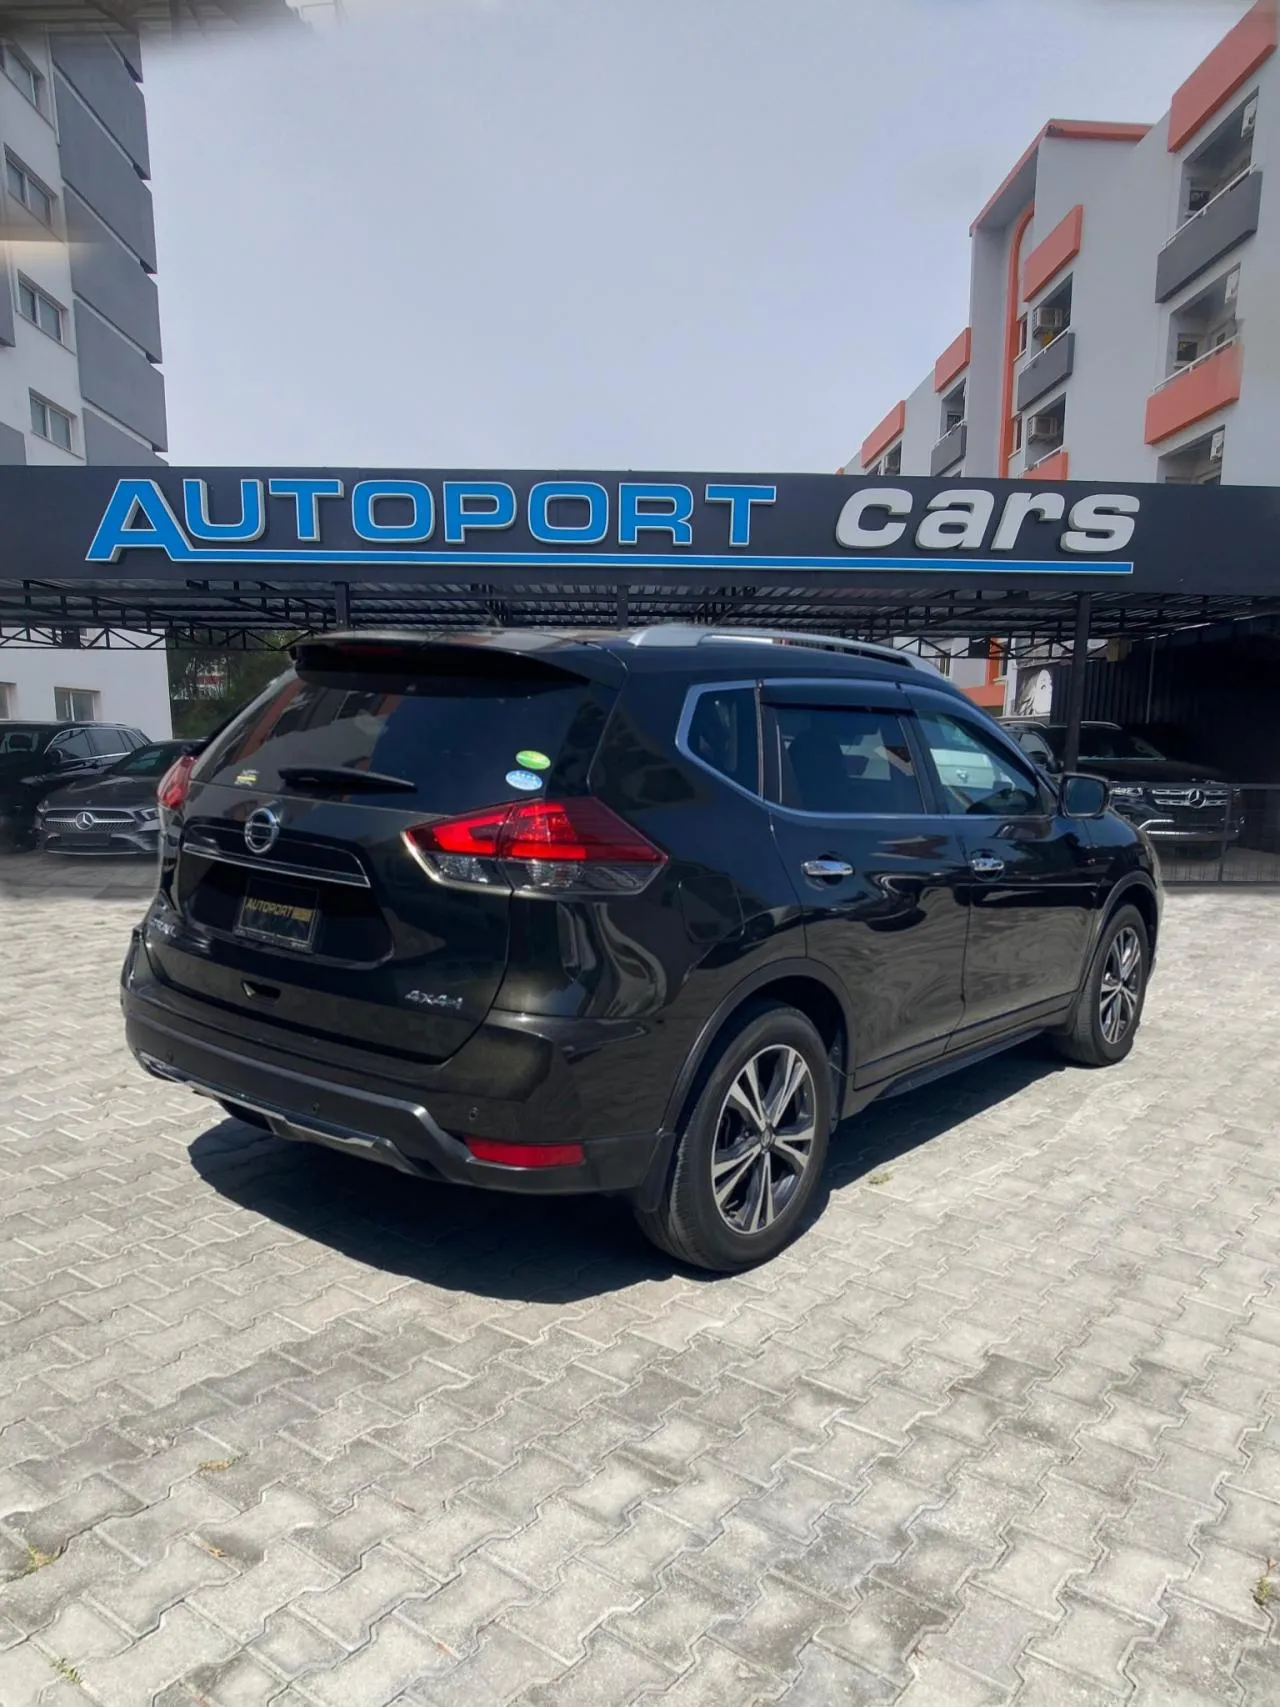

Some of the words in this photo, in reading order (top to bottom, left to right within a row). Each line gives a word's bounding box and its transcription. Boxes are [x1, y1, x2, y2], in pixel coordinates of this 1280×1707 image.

[85, 478, 777, 562] AUTOPORT
[835, 487, 1141, 553] cars
[245, 898, 294, 918] AUTOPORT
